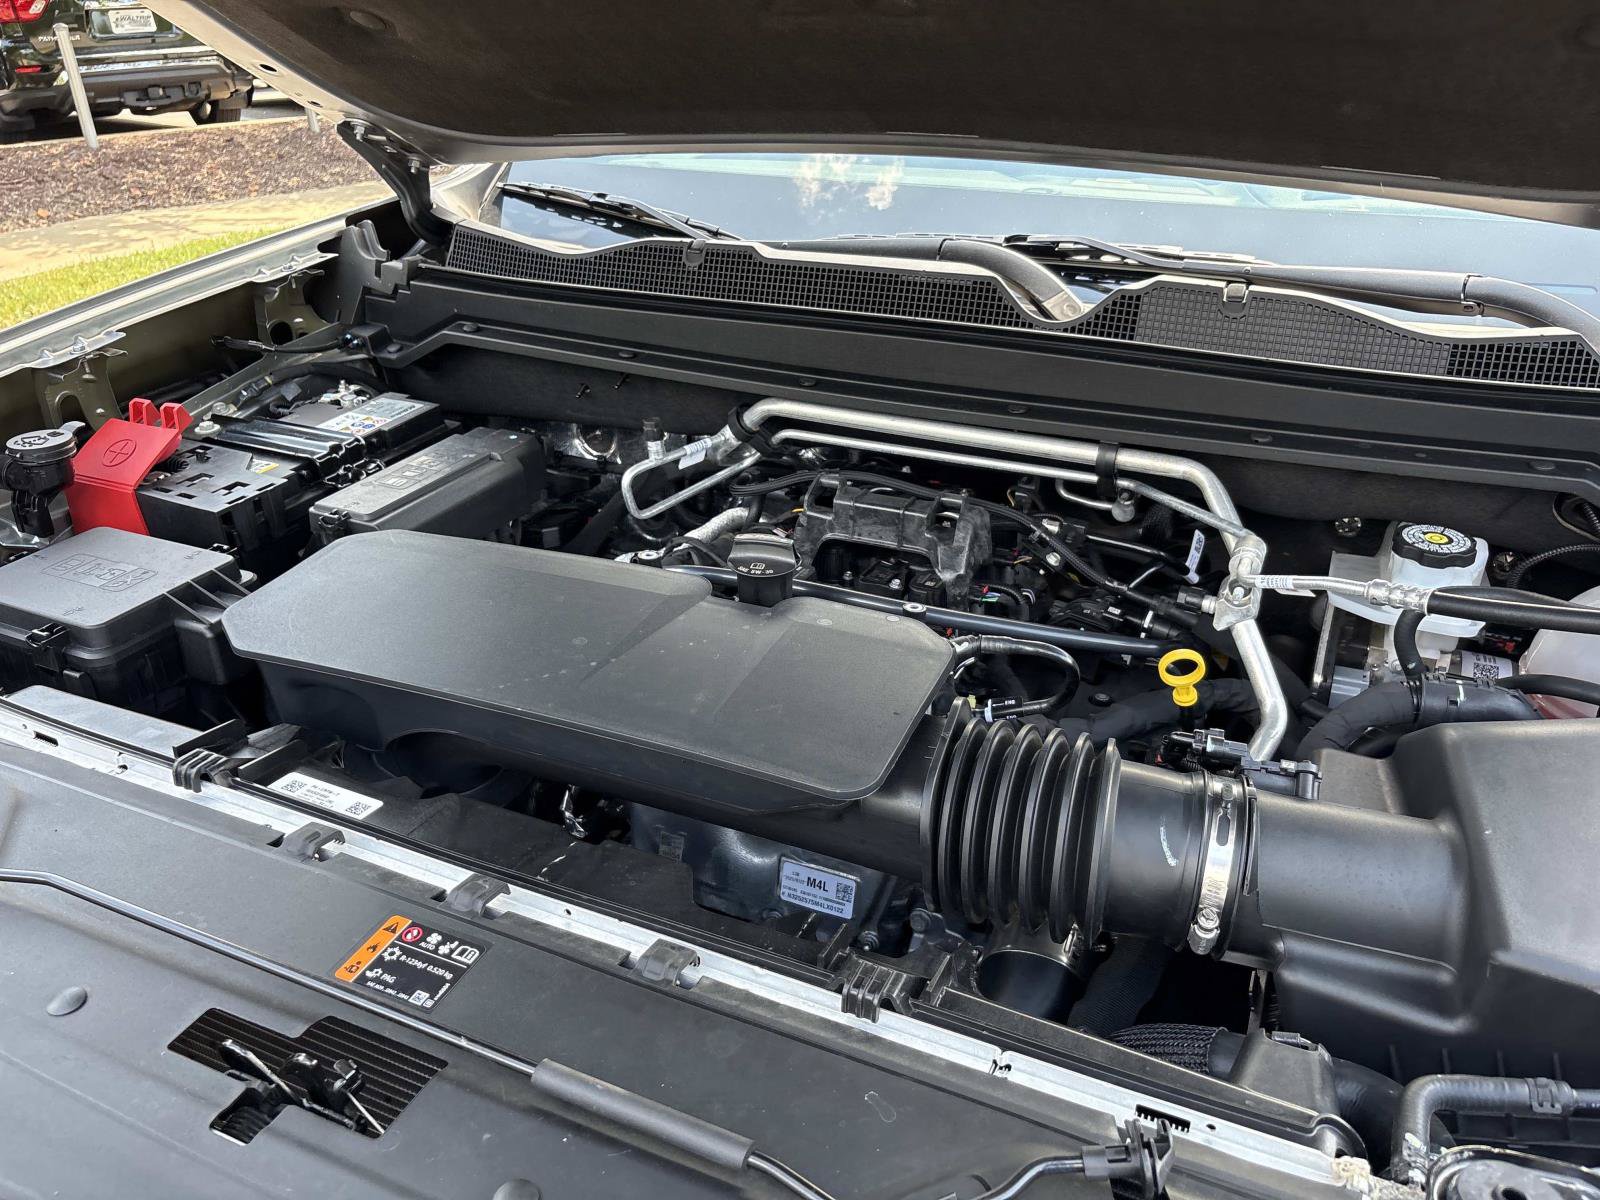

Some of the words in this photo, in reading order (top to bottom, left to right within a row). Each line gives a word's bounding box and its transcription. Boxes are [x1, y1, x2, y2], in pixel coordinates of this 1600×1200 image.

[806, 877, 829, 892] M4L
[419, 941, 436, 950] AUTO
[399, 954, 428, 969] R-1234yf
[427, 965, 445, 976] 0.520
[443, 971, 453, 980] kg
[380, 973, 397, 983] PAG
